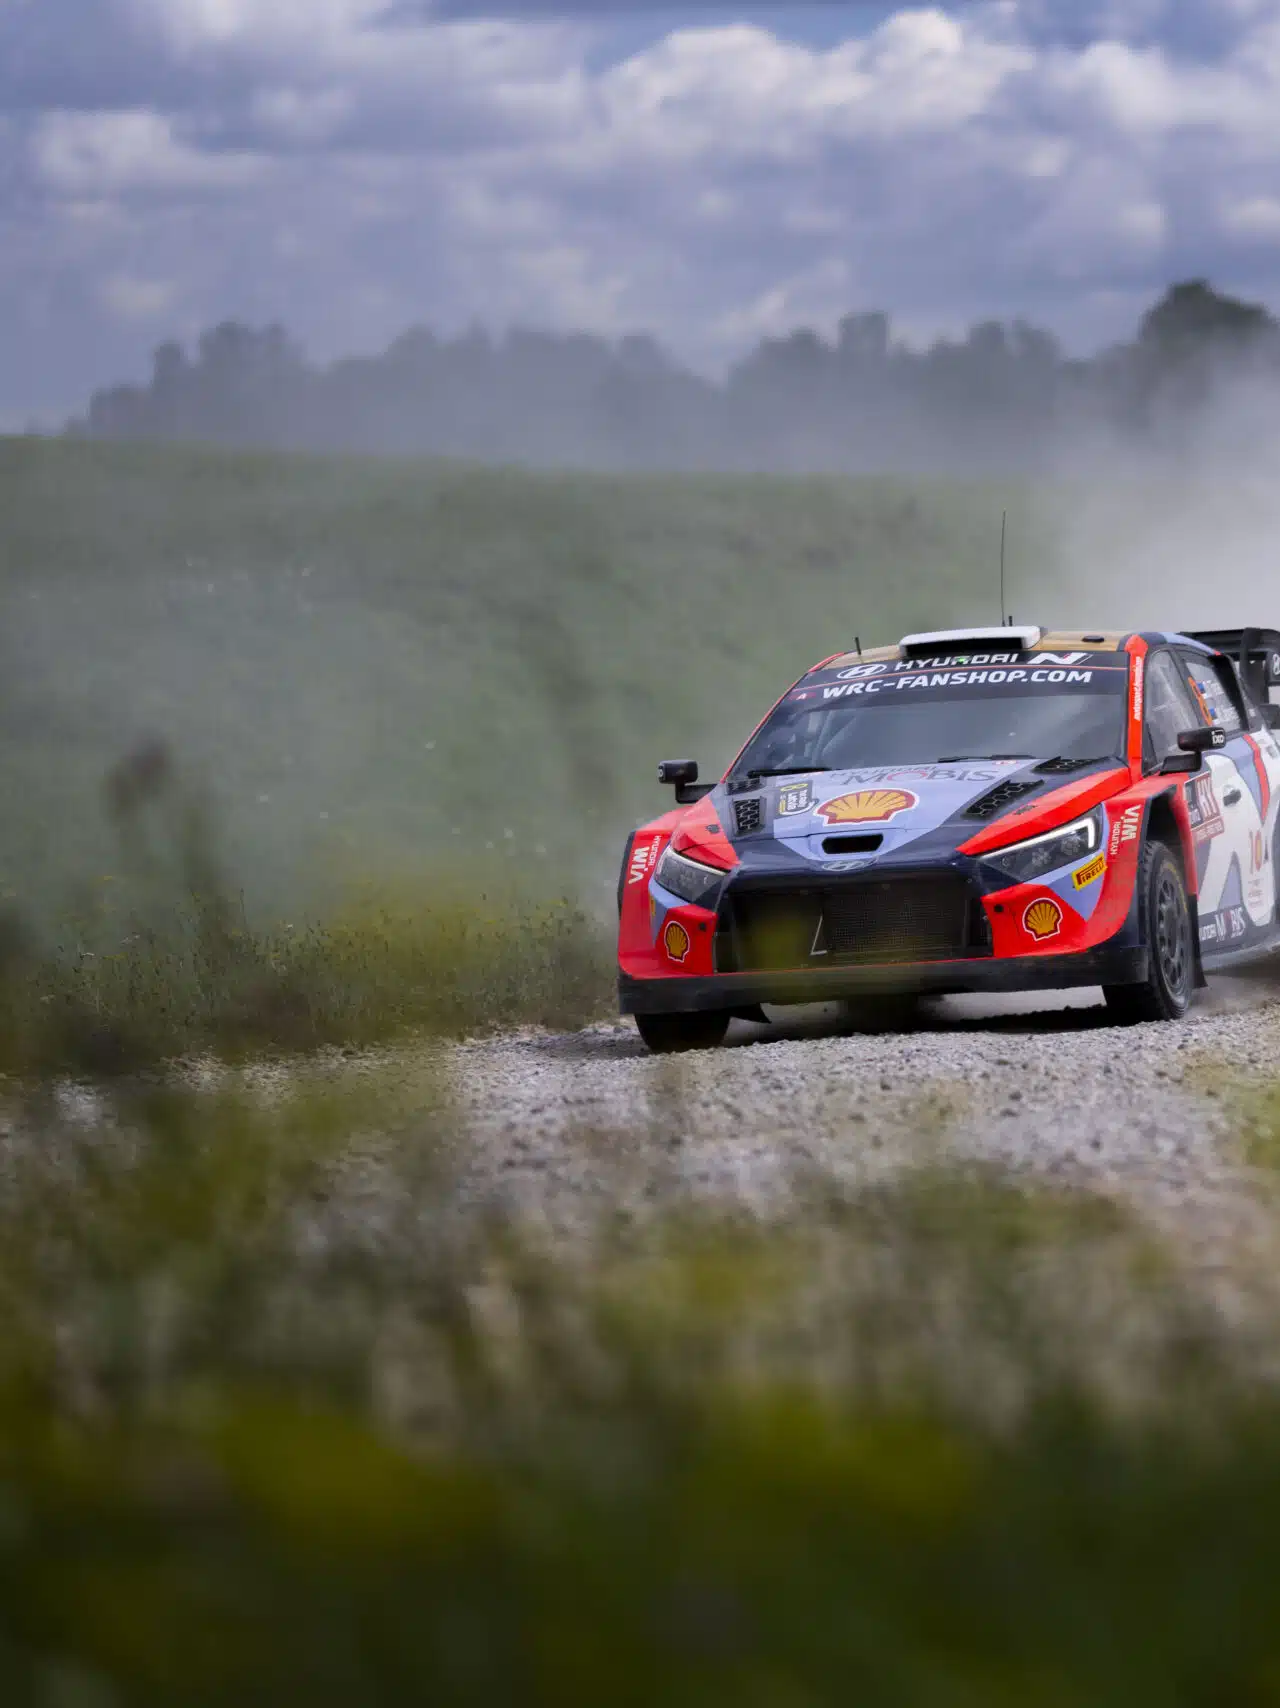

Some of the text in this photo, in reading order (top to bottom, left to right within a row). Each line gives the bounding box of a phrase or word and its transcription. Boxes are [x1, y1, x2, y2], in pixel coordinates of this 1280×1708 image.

[895, 653, 1018, 671] HYUNDAI
[822, 670, 1092, 699] WRC-FANSHOP.COM
[840, 770, 999, 786] MOBIS
[648, 835, 662, 866] HYUNDAI
[1110, 822, 1121, 855] HYUNDAI
[1076, 856, 1104, 885] PIRELLI
